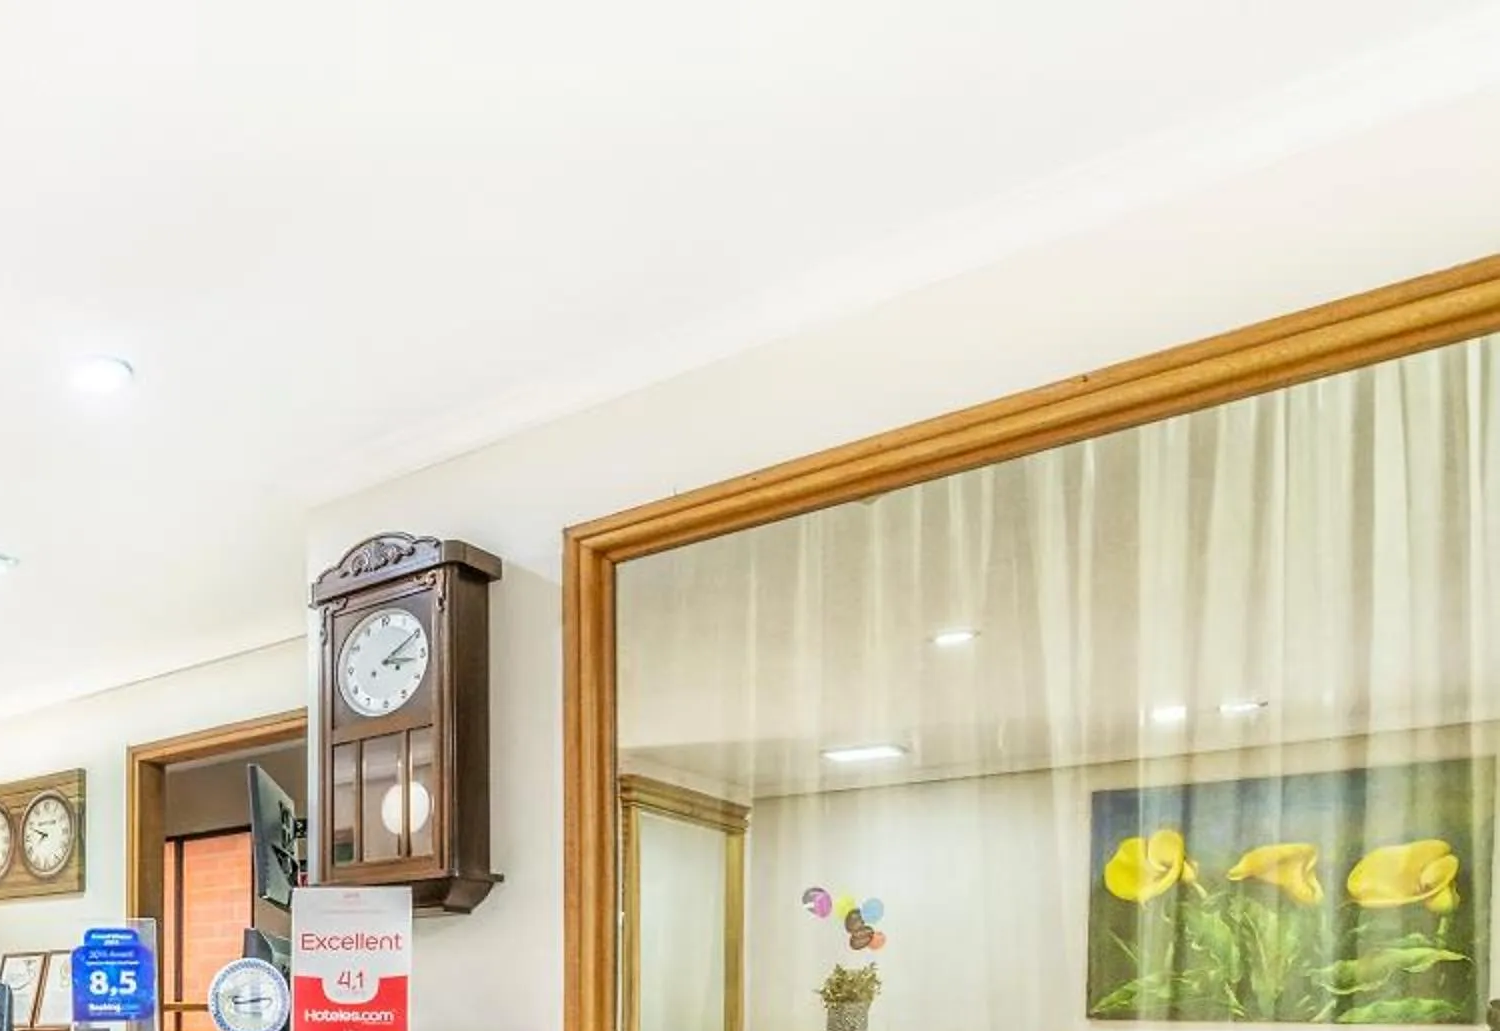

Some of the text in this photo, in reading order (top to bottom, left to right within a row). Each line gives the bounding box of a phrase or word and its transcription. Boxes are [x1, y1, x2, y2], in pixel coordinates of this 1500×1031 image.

[301, 932, 402, 951] Excellent
[89, 970, 138, 997] 8,5
[337, 970, 363, 991] 4,1
